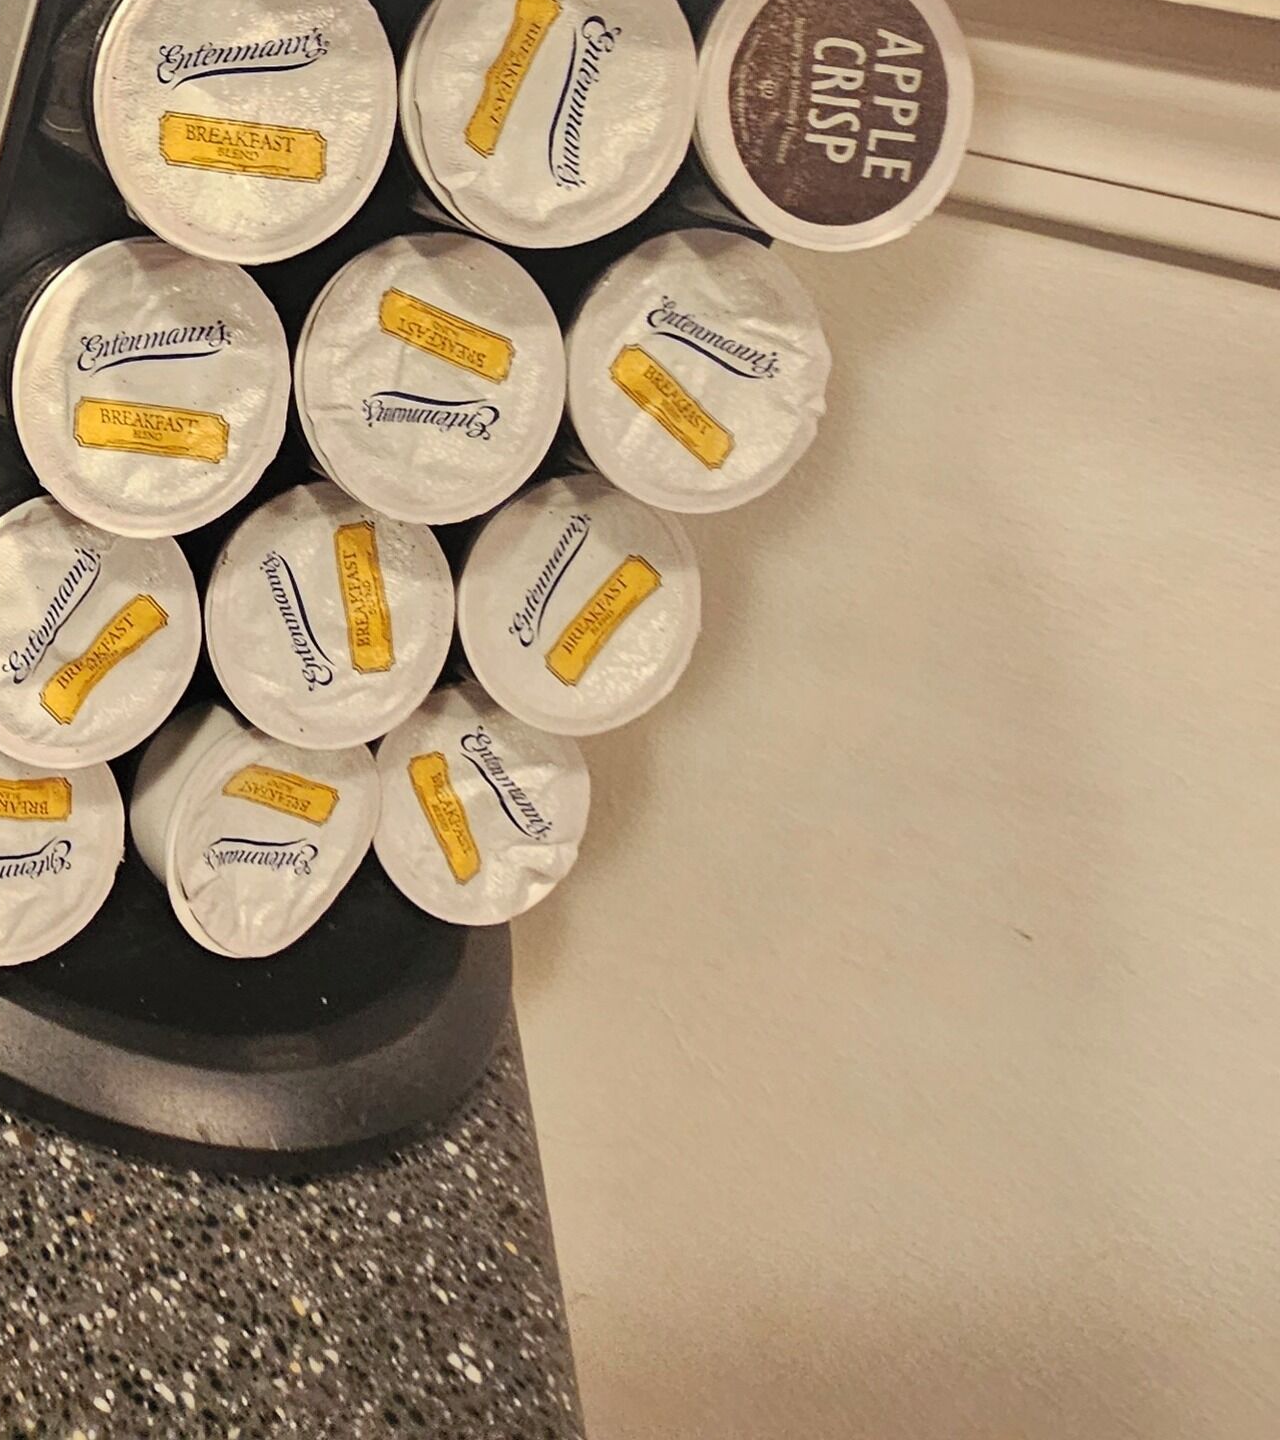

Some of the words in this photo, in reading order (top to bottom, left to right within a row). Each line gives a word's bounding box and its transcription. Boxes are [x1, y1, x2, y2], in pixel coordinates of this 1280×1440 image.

[156, 26, 331, 84] Entenmann's
[489, 22, 542, 125] BREAKFAST
[185, 124, 297, 153] BREAKFAST
[554, 15, 623, 192] Entenmann's
[804, 36, 868, 164] CRISP
[861, 27, 925, 183] APPLE
[216, 146, 260, 161] BLEND
[76, 319, 232, 372] Entenmann's
[398, 316, 488, 369] BREAKFAST
[646, 294, 780, 380] Entenmann's
[99, 407, 200, 435] BREAKFAST
[361, 398, 501, 441] Entenmann's
[643, 364, 713, 436] BREAKFAST
[1, 546, 102, 685] Entenmann's
[259, 551, 334, 692] Entenmann's
[343, 550, 372, 648] BREAKFAST
[508, 513, 592, 648] Entenmann's
[561, 573, 629, 655] BREAKFAST
[56, 611, 134, 690] BREAKFAST
[460, 725, 554, 841] Entenmann's
